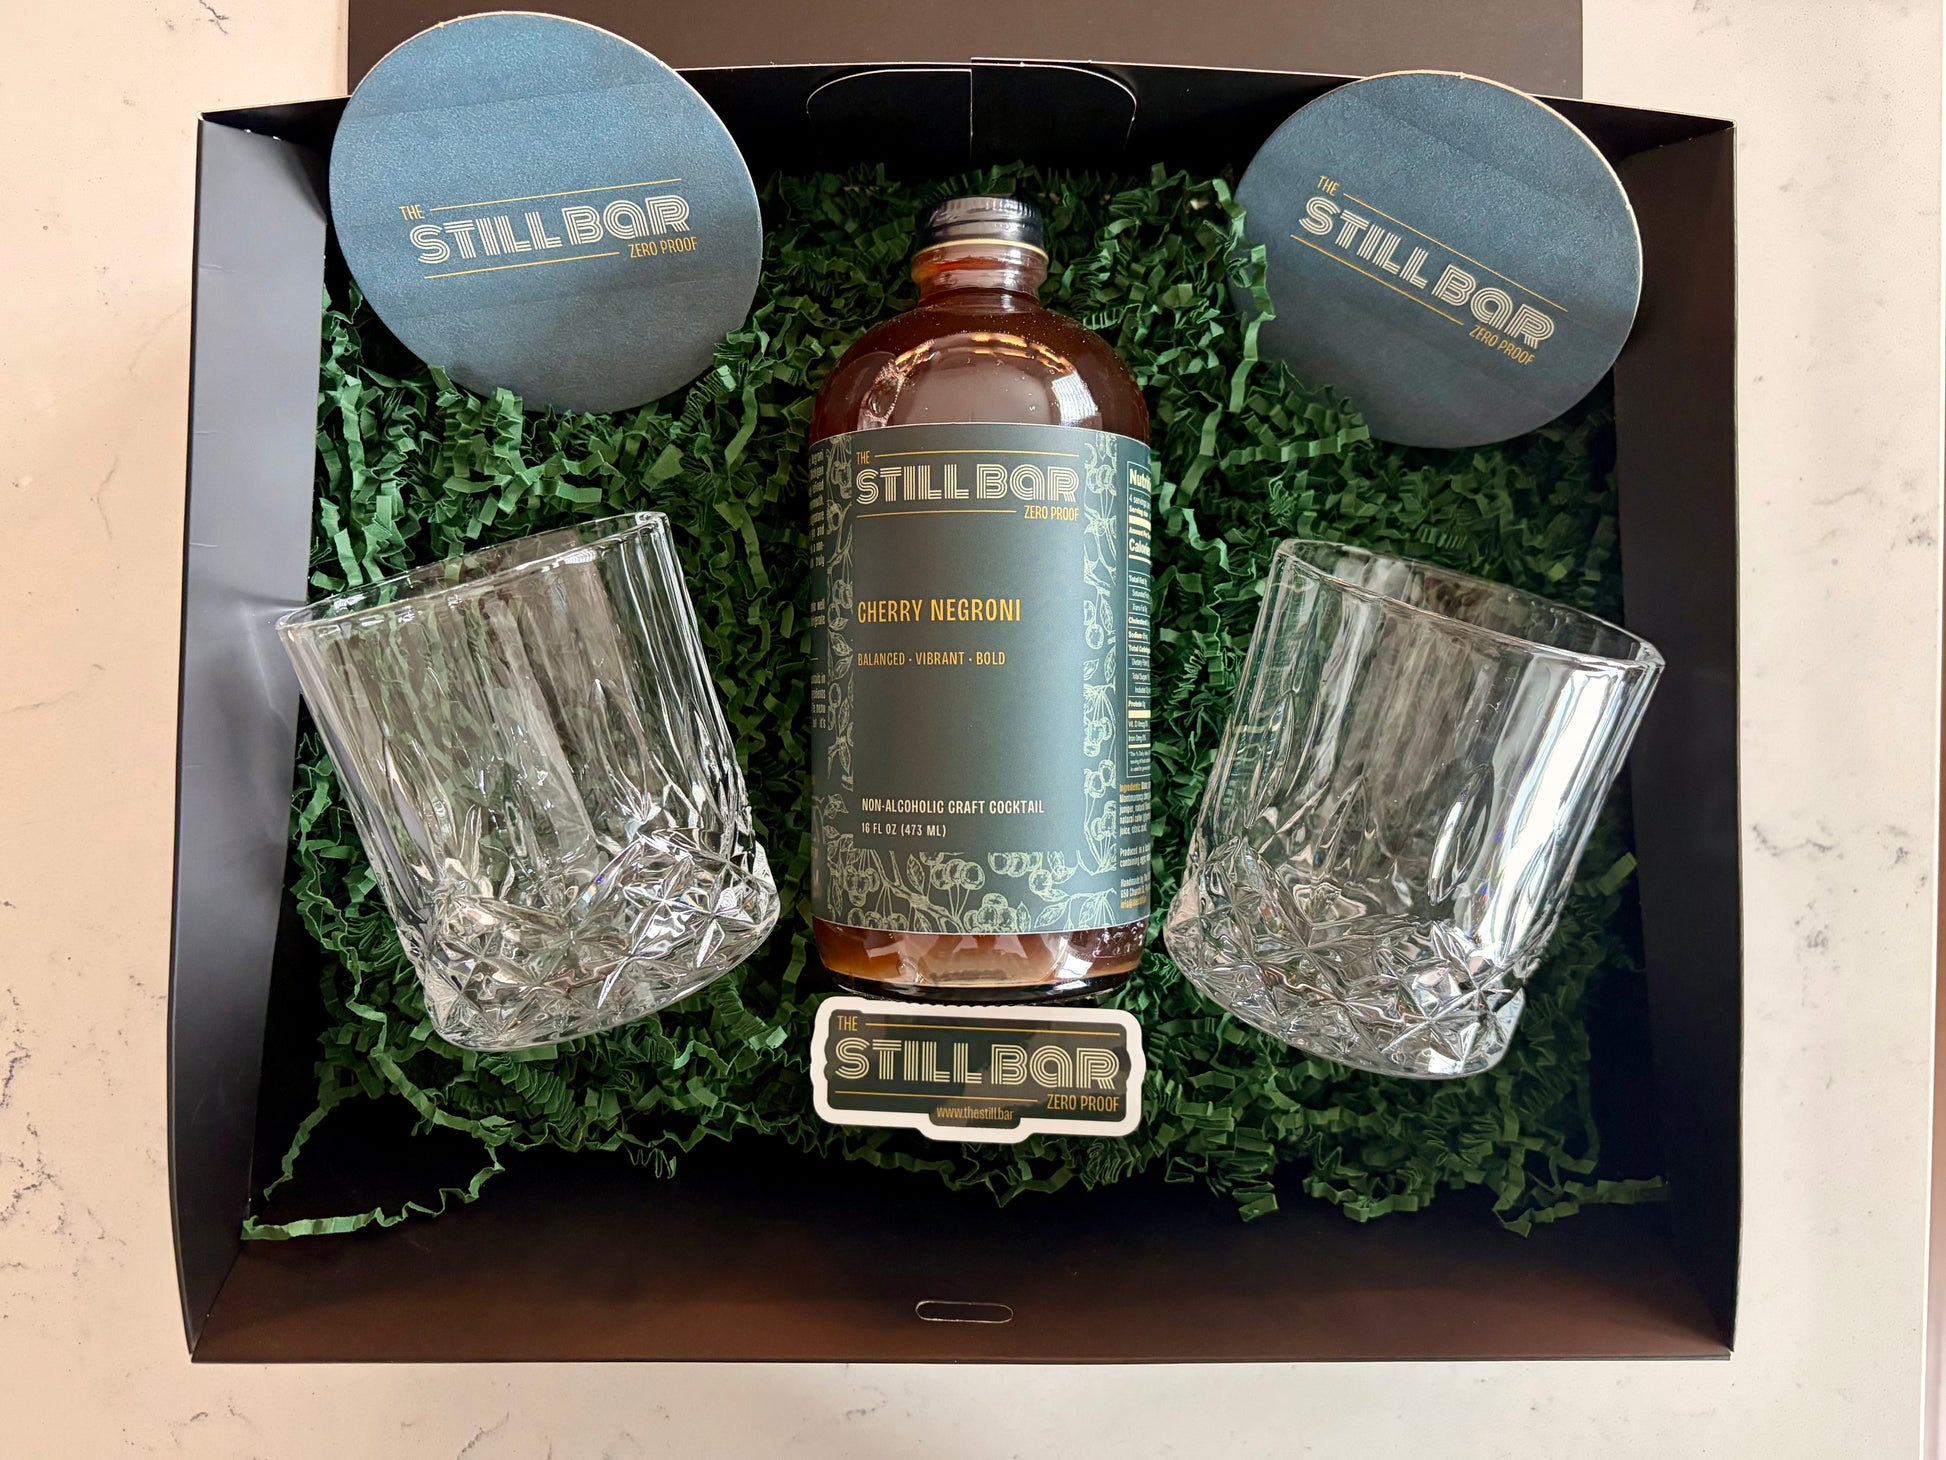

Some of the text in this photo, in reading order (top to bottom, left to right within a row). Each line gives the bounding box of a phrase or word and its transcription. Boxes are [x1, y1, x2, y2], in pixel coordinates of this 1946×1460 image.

[1316, 175, 1341, 197] THE
[399, 204, 425, 220] THE
[409, 211, 563, 264] STILL
[628, 236, 697, 259] ZERO PROOF
[1298, 196, 1429, 290] STILL
[1469, 324, 1535, 366] ZERO PROOF
[856, 451, 870, 465] THE
[856, 464, 970, 505] STILL
[1024, 505, 1079, 521] ZERO PROOF
[857, 598, 1021, 624] CHERRY NEGRONI
[857, 651, 1006, 666] BALANCED VIBRANT BOLD
[862, 798, 1045, 814] NON-ALCOHOLIC CRAFT COCKTAIL
[861, 822, 947, 838] 16 FL OZ (473 ML)
[837, 1015, 858, 1032] THE
[835, 1037, 983, 1085] STILL
[1047, 1093, 1120, 1113] ZERO PROOF
